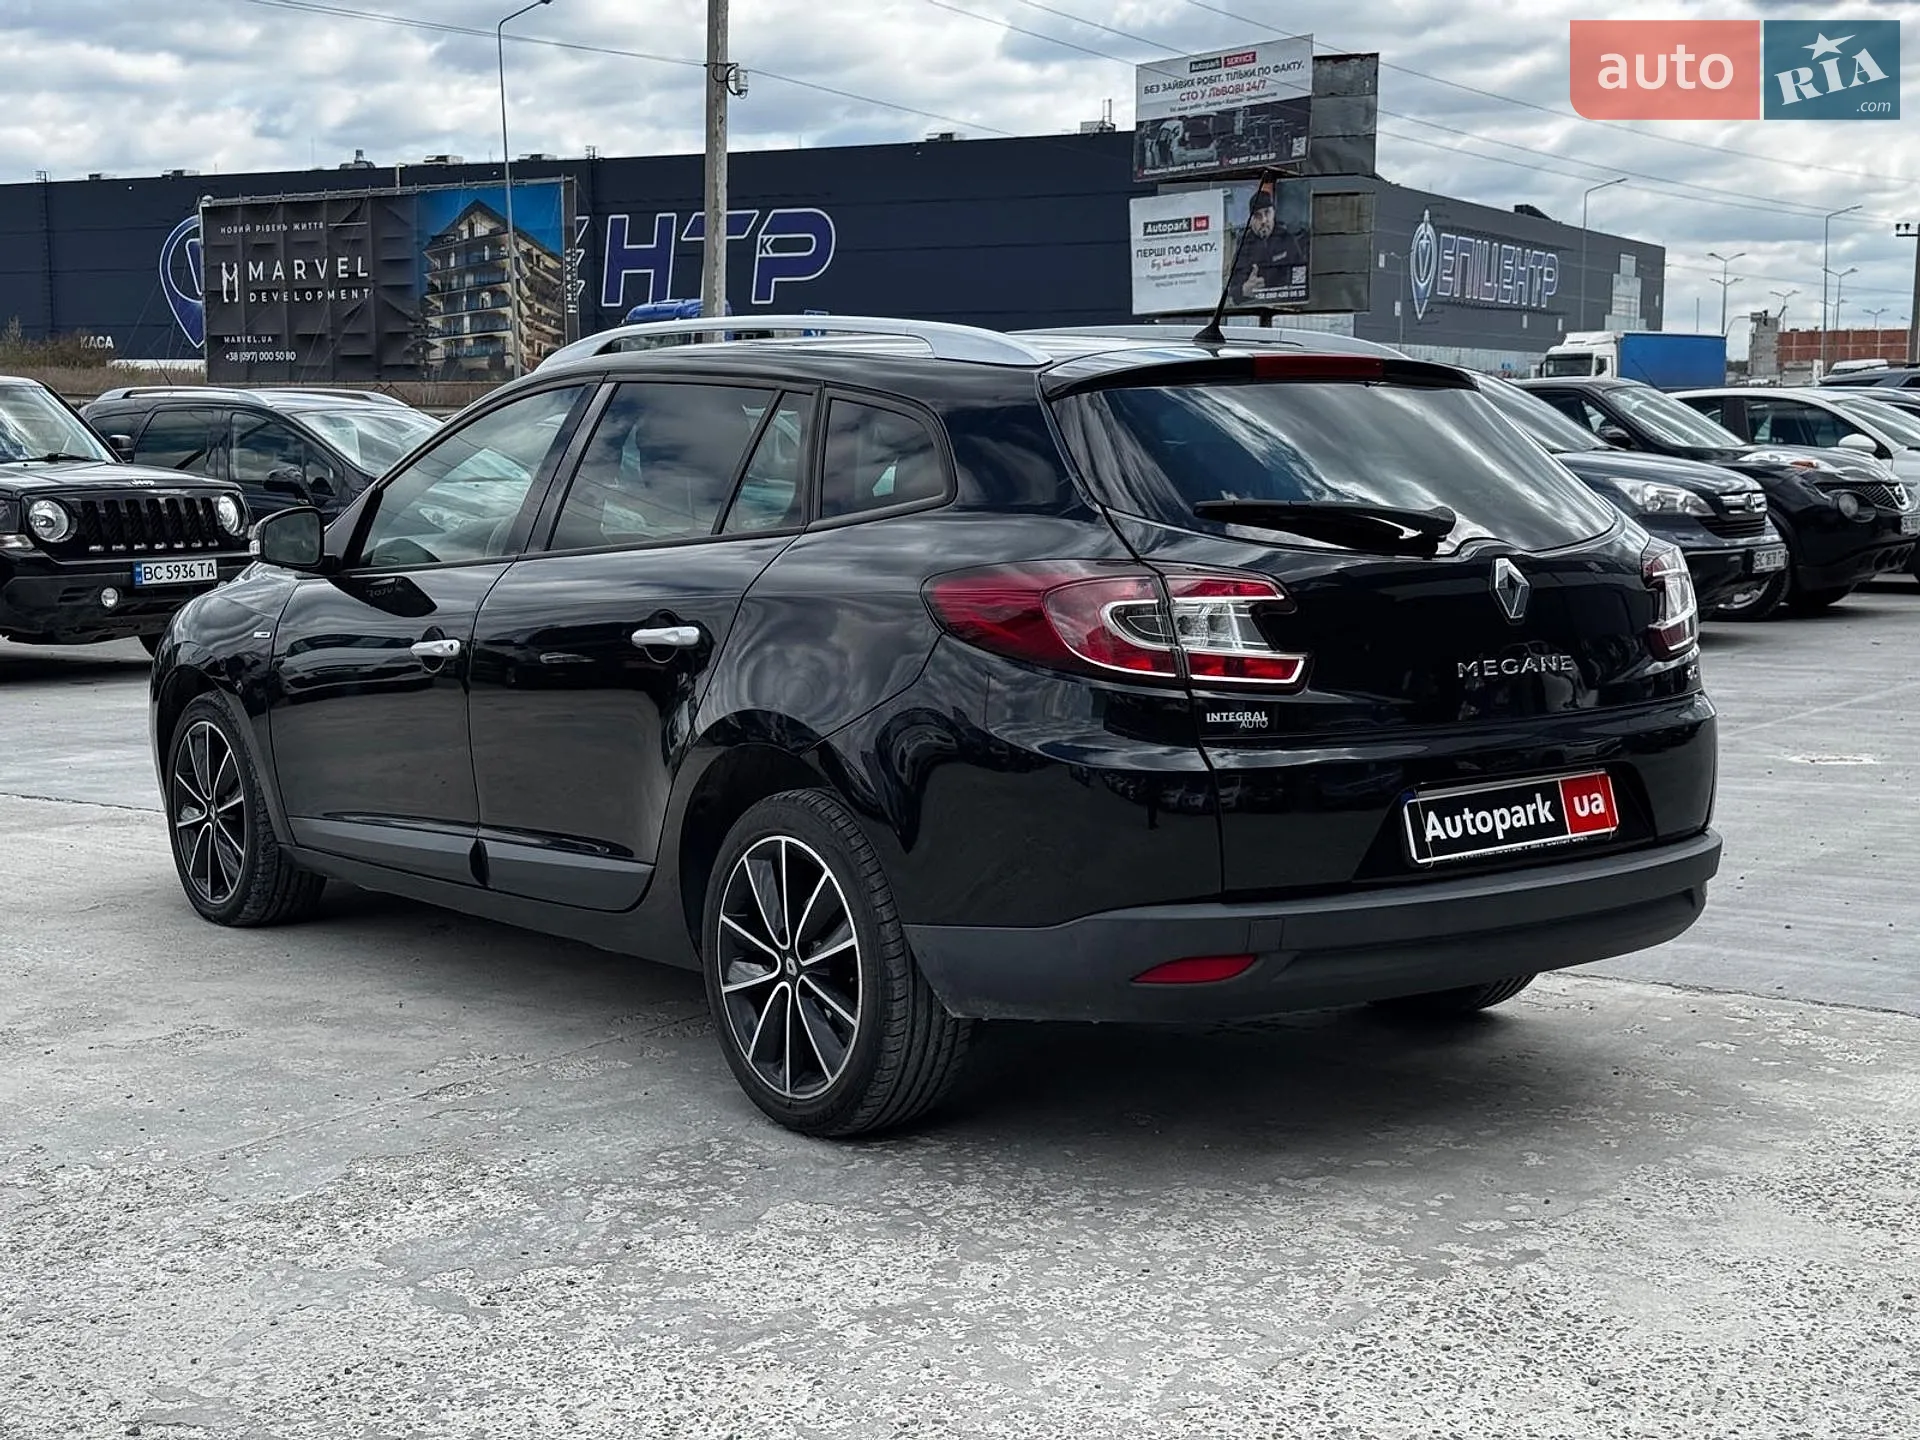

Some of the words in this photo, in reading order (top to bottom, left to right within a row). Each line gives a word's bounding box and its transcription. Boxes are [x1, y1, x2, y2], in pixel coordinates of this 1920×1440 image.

[1225, 53, 1255, 66] SERVICE
[1143, 84, 1160, 95] БЕЗ
[1161, 79, 1196, 92] ЗАЙВИХ
[1196, 75, 1224, 88] РОБІТ.
[1225, 69, 1257, 82] ТІЛЬКИ
[1257, 66, 1271, 77] ПО
[1272, 60, 1305, 74] ФАКТУ.
[1179, 90, 1199, 103] СТО
[1199, 89, 1208, 101] У
[1208, 84, 1245, 98] ЛЬВОВІ
[1245, 79, 1267, 94] 24/7
[220, 223, 251, 234] НОВИЙ
[255, 223, 288, 233] РІВЕНЬ
[293, 221, 324, 232] ЖИТТЯ
[1145, 219, 1190, 234] Autopark
[1136, 246, 1166, 259] ПЕРШІ
[1167, 245, 1182, 256] ПО
[1183, 241, 1217, 254] ФАКТУ.
[248, 255, 369, 282] MARVEL
[1436, 232, 1559, 308] ЕПІЦЕНТР
[249, 287, 371, 303] DEVELOPMENT
[80, 335, 114, 349] КАСА
[223, 335, 273, 344] MARVEL.UA
[225, 351, 238, 361] +38
[239, 351, 258, 363] (097)
[259, 351, 274, 361] 000
[275, 351, 285, 361] 50
[143, 565, 163, 581] BC
[166, 563, 196, 580] 5936
[197, 562, 216, 577] TA
[1457, 655, 1574, 678] MEGANE
[1206, 711, 1268, 723] INTEGRAL
[1239, 719, 1269, 729] AUTO
[1424, 792, 1555, 842] Autopark
[1572, 791, 1606, 818] ua
